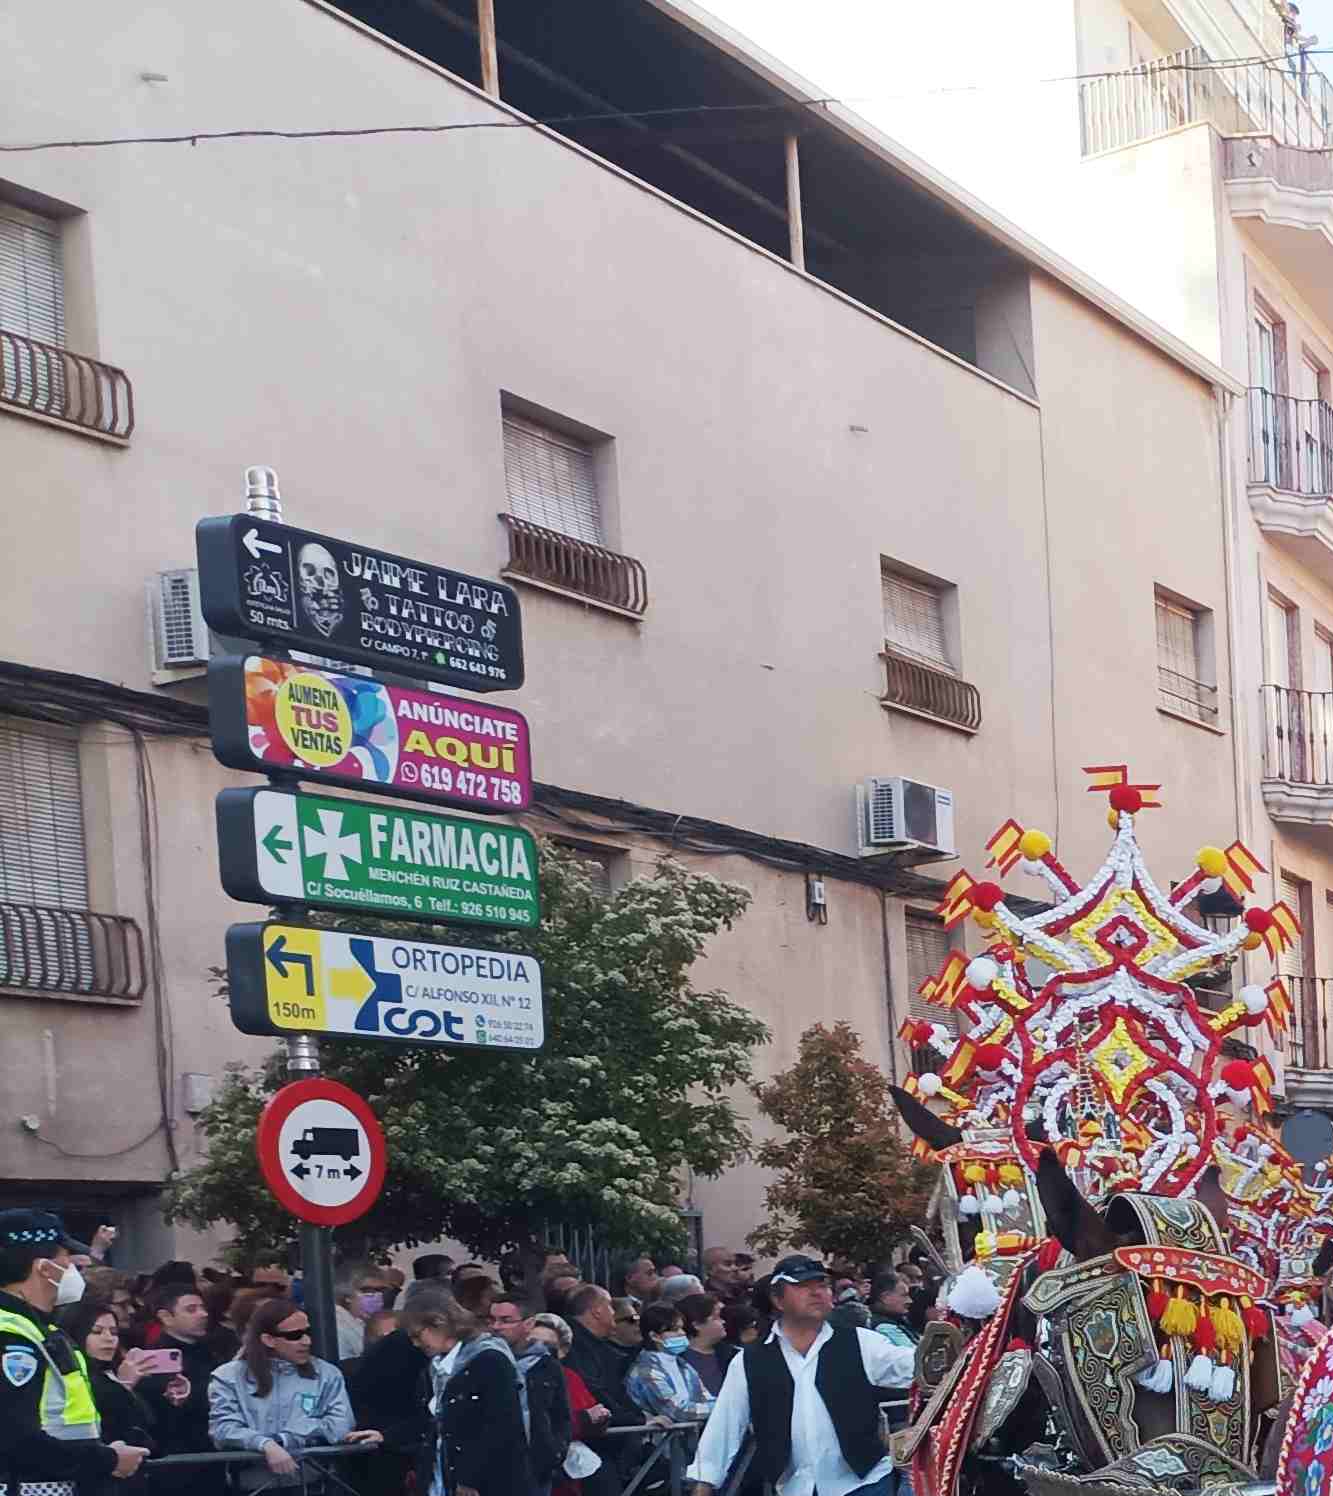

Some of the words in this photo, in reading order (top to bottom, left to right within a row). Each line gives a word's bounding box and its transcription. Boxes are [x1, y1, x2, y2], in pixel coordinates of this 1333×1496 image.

[344, 552, 429, 596] JAIME
[438, 576, 508, 616] LARA
[249, 609, 264, 625] 50
[386, 594, 475, 634] TATTOO
[361, 612, 499, 662] BODYPIERCING
[374, 640, 410, 657] CAMPO
[288, 682, 339, 711] AUMENTA
[291, 705, 338, 733] TUS
[398, 699, 519, 742] ANÚNCIATE
[291, 727, 342, 756] VENTAS
[404, 730, 516, 773] AQUÍ
[420, 766, 454, 791] 619
[456, 771, 488, 797] 472
[491, 779, 521, 805] 758
[369, 813, 532, 881] FARMACIA
[307, 881, 321, 896] C/
[324, 885, 412, 909] Socuéllamos,
[415, 896, 422, 909] 6
[461, 901, 482, 916] 926
[509, 908, 530, 922] 945
[369, 866, 430, 887] MENCHÉN
[433, 875, 460, 891] RUIZ
[463, 879, 533, 901] CASTAÑEDA
[392, 946, 530, 983] ORTOPEDIA
[273, 1001, 316, 1020] 150m
[405, 985, 418, 998] C/
[422, 987, 479, 1004] ALFONSO
[519, 997, 531, 1010] 12
[315, 1165, 323, 1178] 7
[328, 1169, 340, 1179] m
